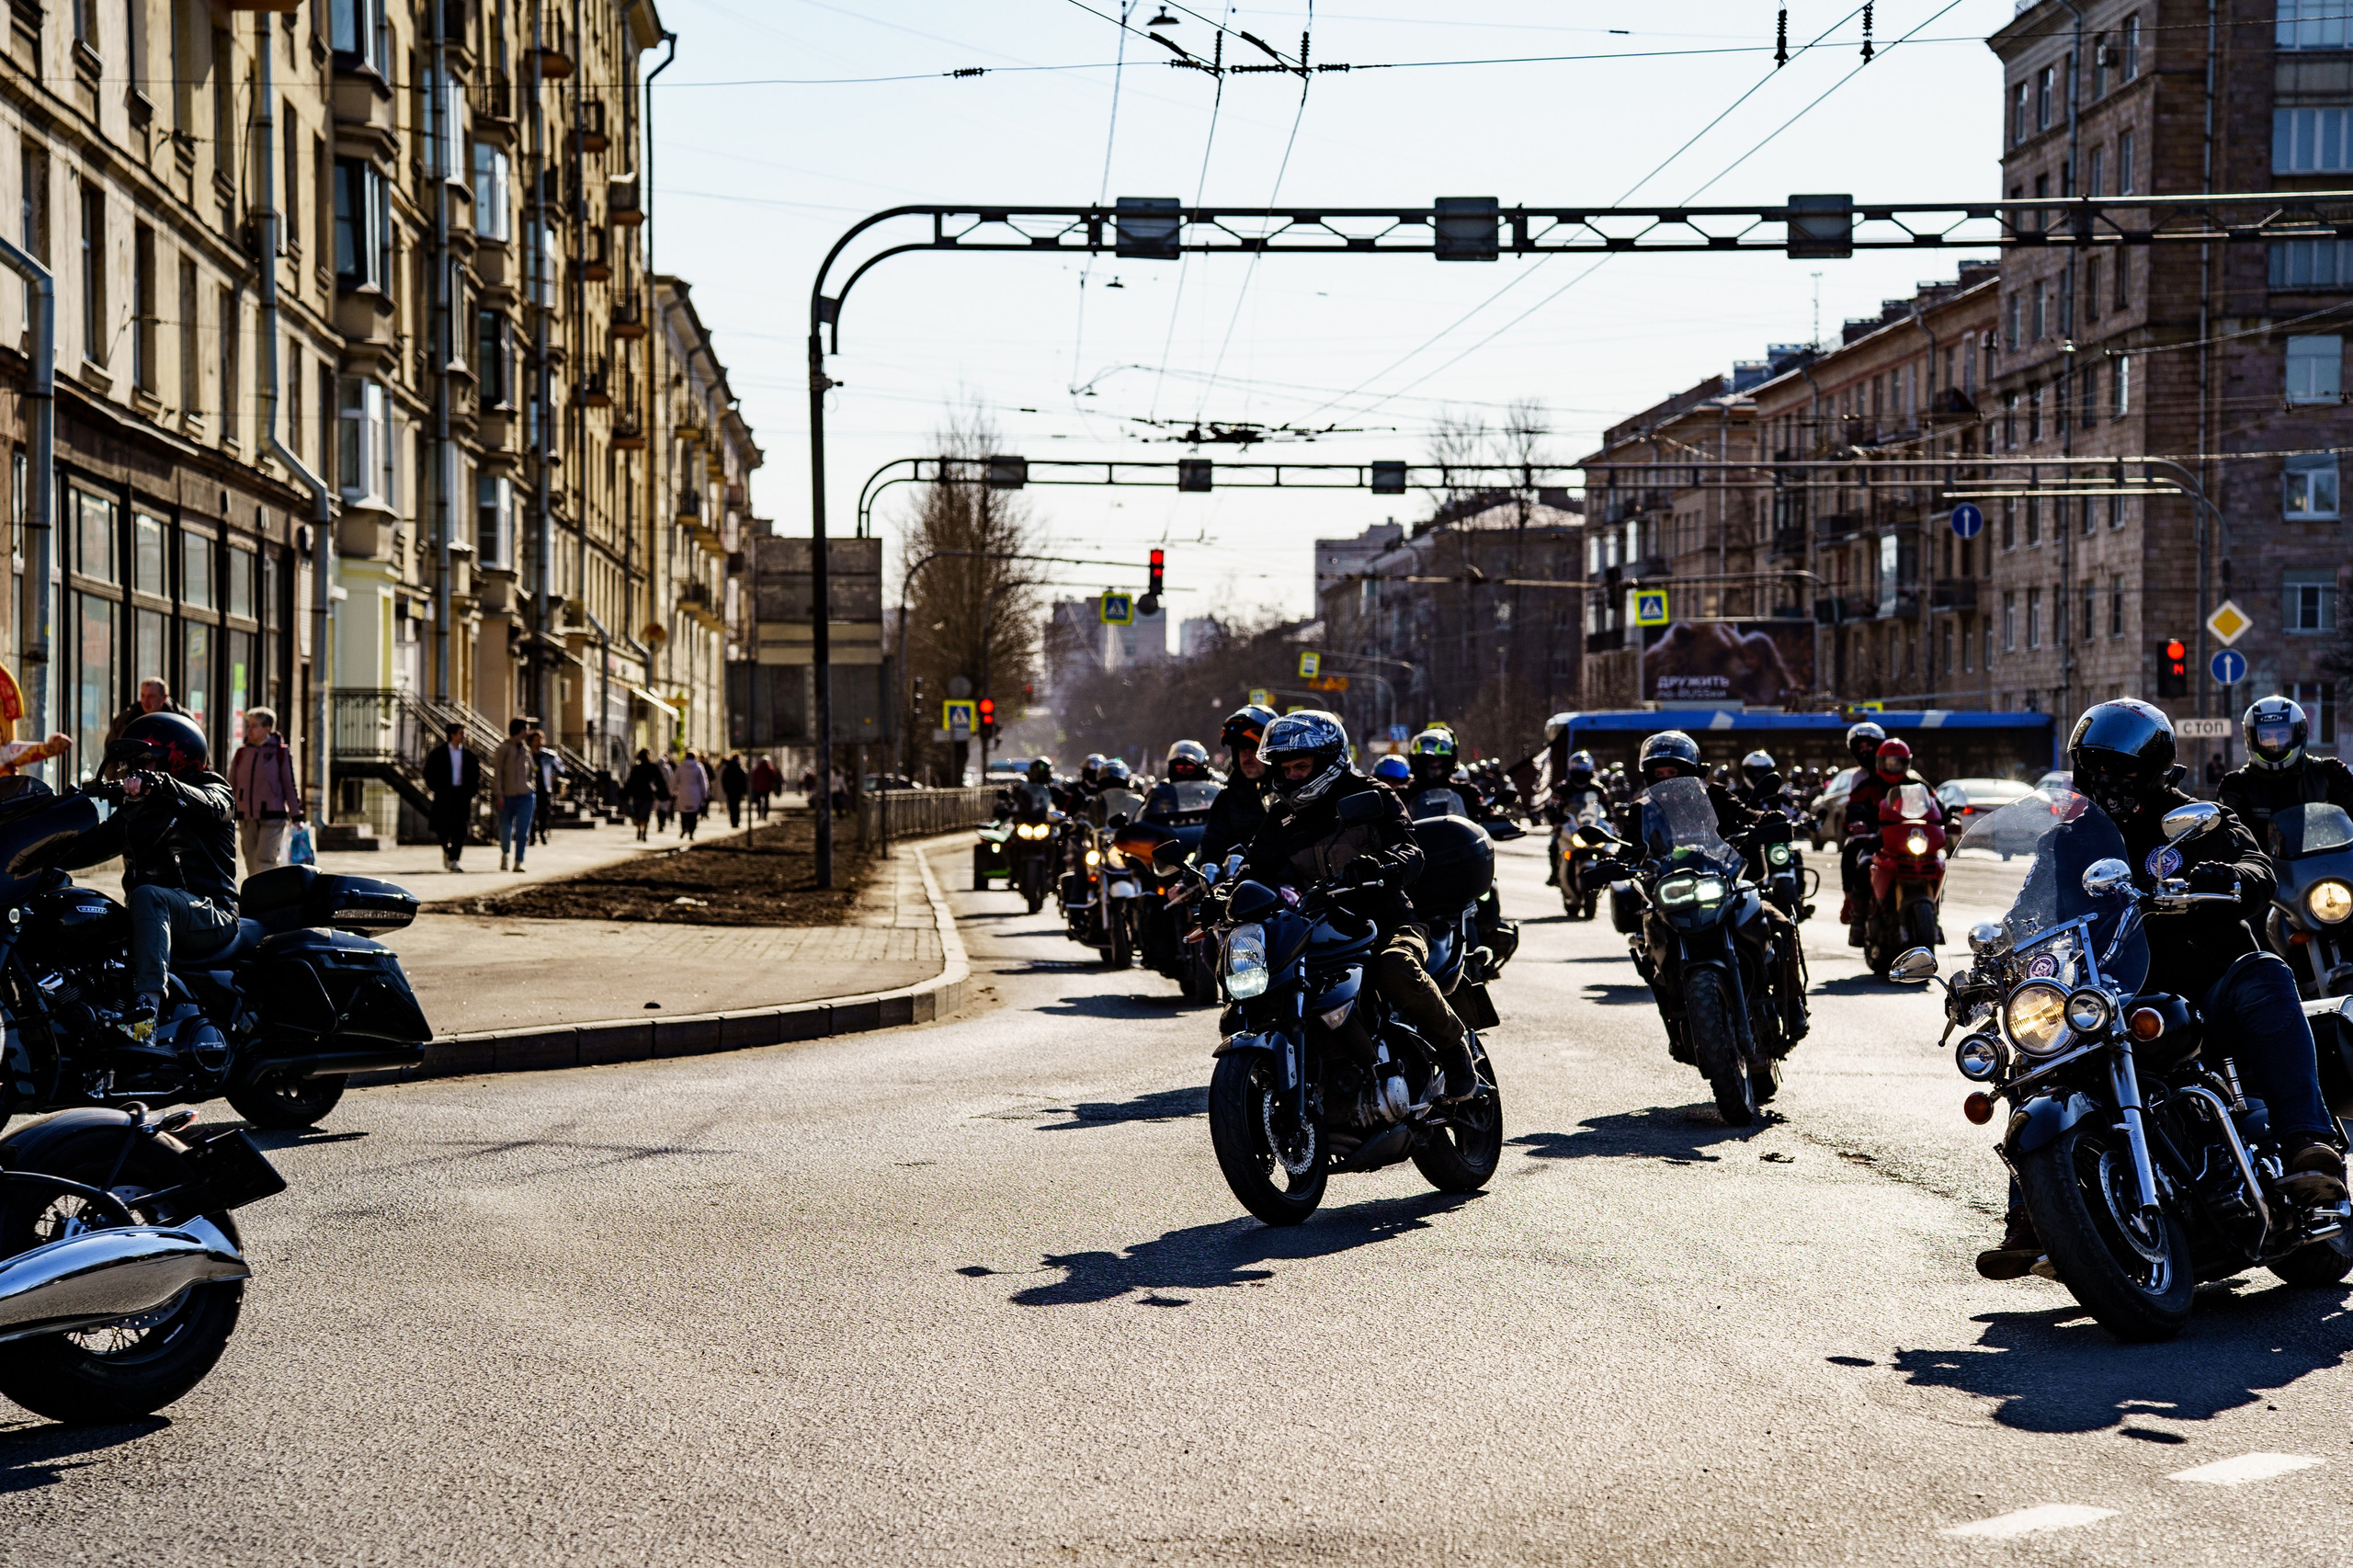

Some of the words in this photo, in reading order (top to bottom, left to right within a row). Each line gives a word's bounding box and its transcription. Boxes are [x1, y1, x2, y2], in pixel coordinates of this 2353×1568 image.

[1657, 676, 1730, 688] ДРУЖИТЬ
[2129, 707, 2146, 718] RIDE
[2183, 721, 2224, 735] СТОП
